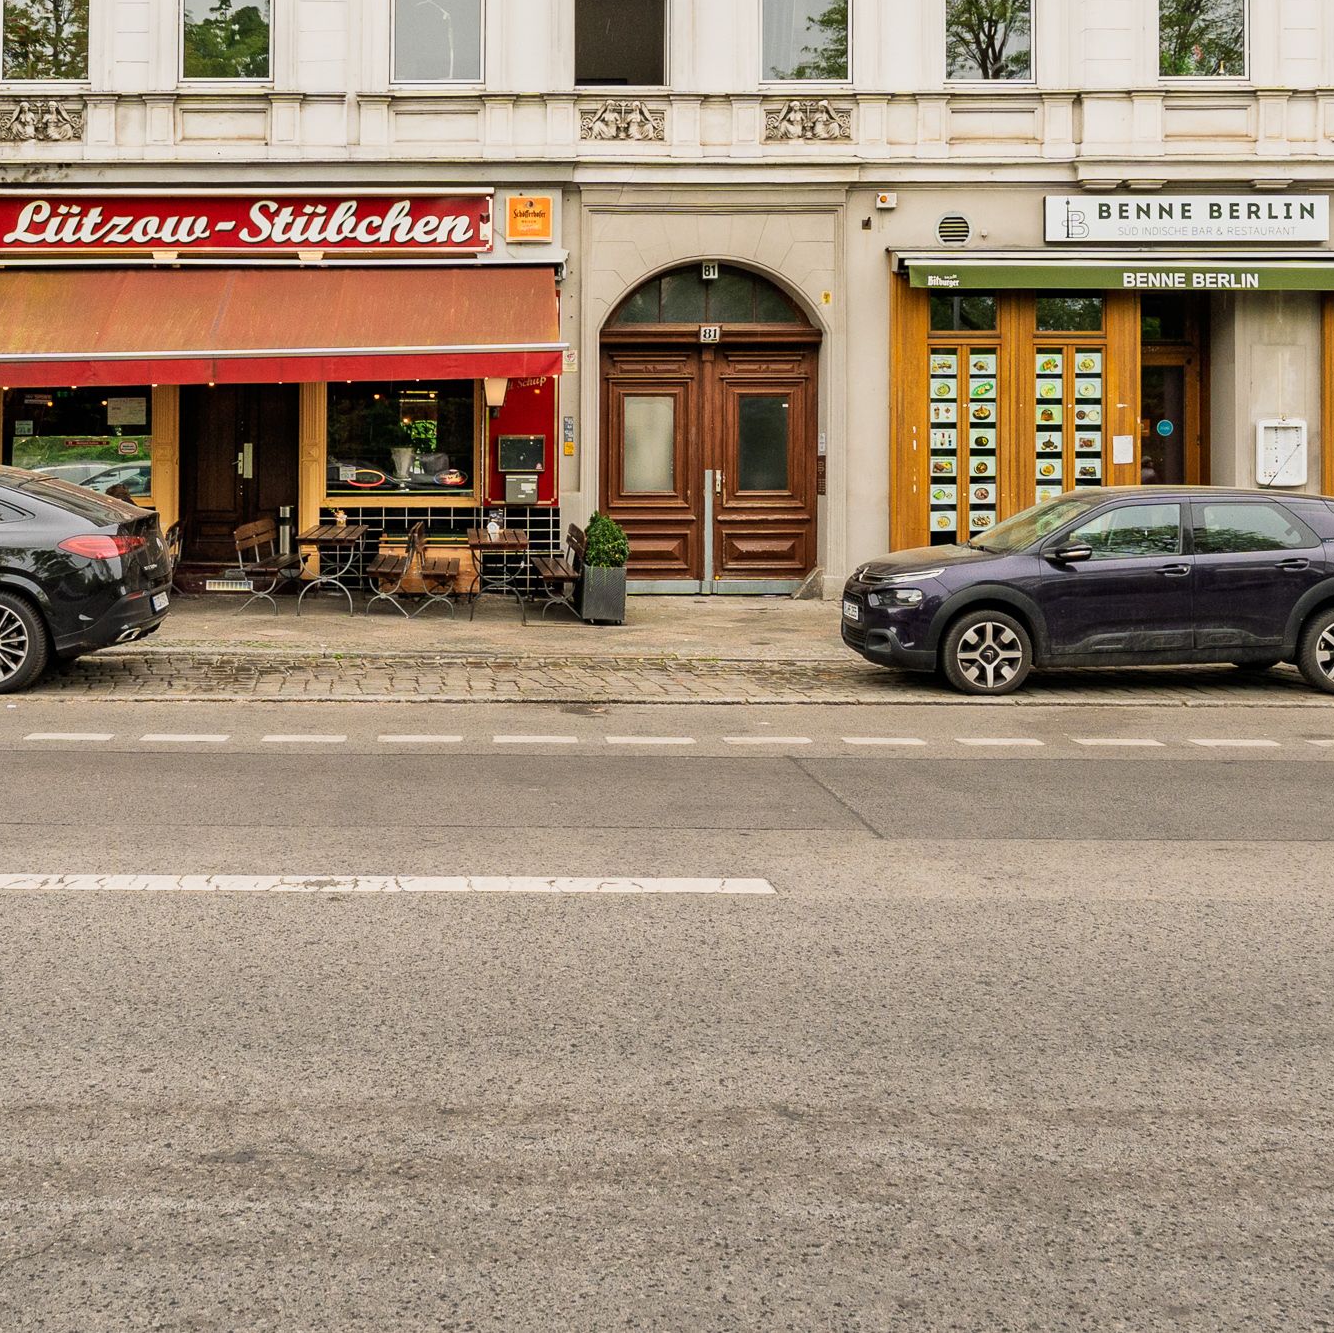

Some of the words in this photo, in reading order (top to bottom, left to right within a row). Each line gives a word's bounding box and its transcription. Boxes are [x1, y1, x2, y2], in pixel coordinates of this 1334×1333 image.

[1098, 202, 1192, 220] BENNE
[1209, 202, 1315, 220] BERLIN
[3, 199, 474, 244] Lützow-Stübchen
[1141, 226, 1188, 236] INDISCHE
[1191, 226, 1213, 236] BAR
[1216, 226, 1223, 236] &
[1227, 226, 1297, 236] RESTAURANT
[704, 264, 716, 277] 81
[1123, 272, 1186, 288] BENNE
[1192, 273, 1259, 289] BERLIN
[703, 328, 717, 339] 81
